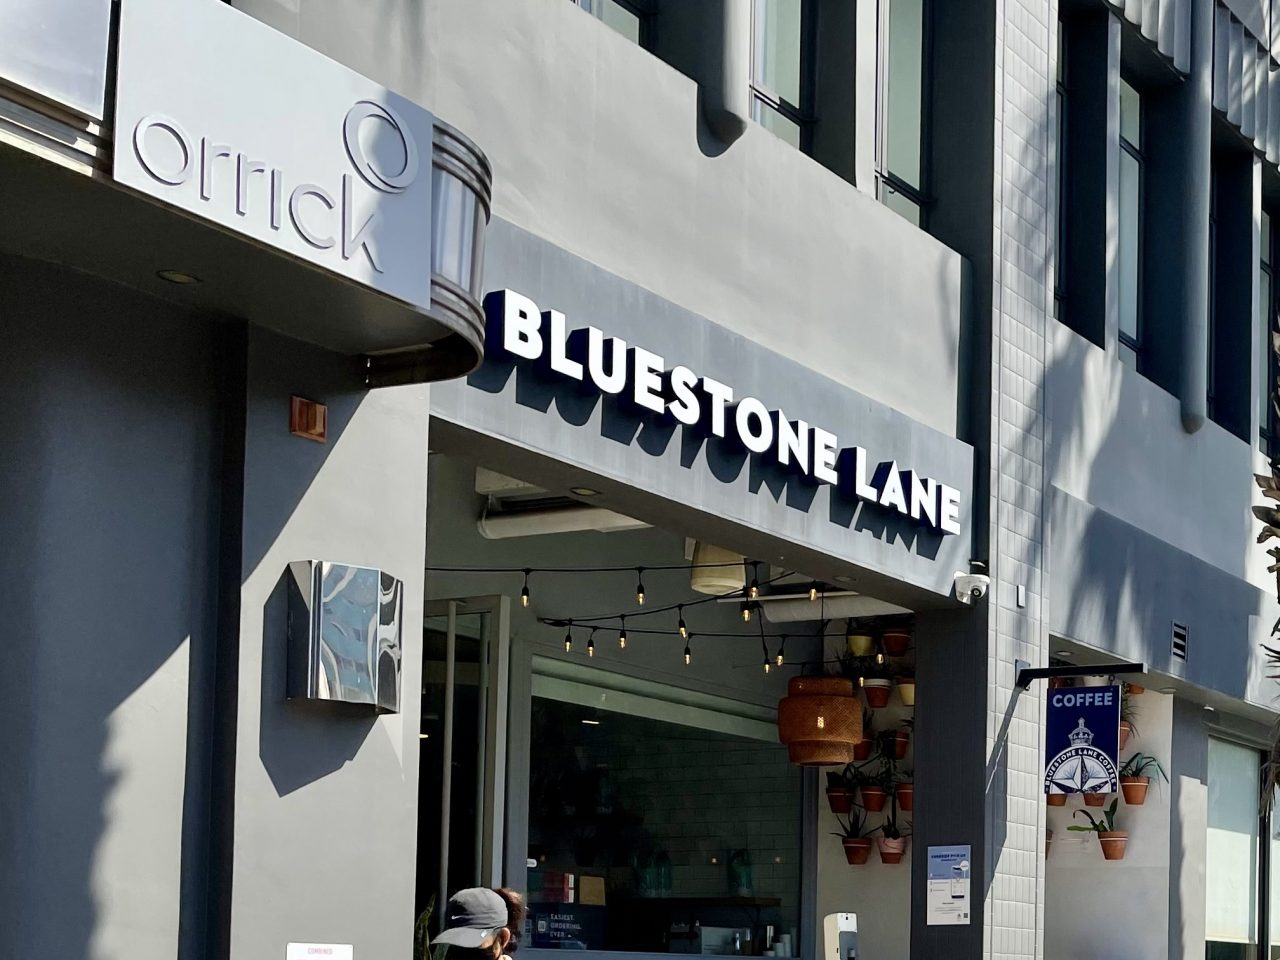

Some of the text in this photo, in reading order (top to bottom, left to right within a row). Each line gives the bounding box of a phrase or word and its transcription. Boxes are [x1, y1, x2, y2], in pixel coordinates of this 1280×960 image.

[503, 287, 962, 537] BLUESTONE LANE
[1051, 691, 1114, 708] COFFEE
[1045, 748, 1118, 787] BLUESTONE LANE COFFEE
